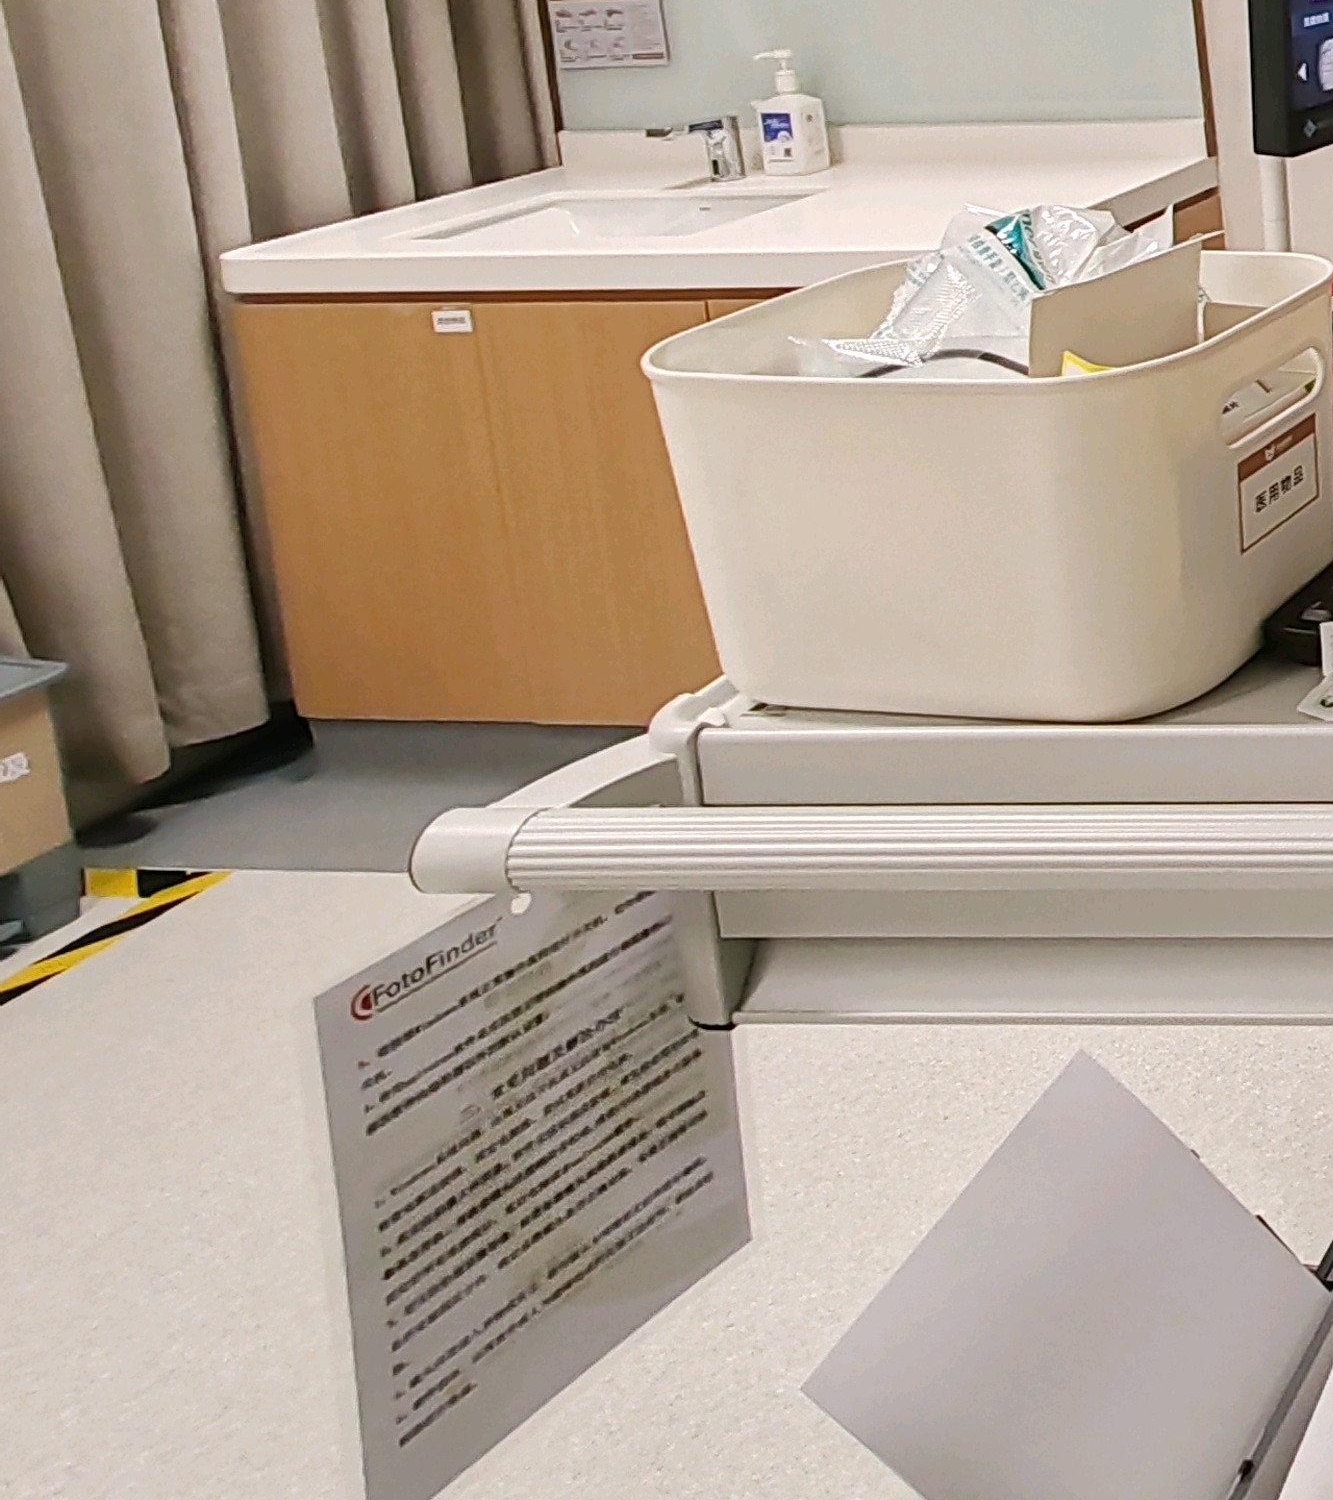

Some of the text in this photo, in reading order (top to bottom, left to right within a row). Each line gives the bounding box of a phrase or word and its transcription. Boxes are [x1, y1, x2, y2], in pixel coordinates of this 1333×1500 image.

[1254, 465, 1304, 513] 医用物品
[371, 924, 499, 1008] FotoFinder
